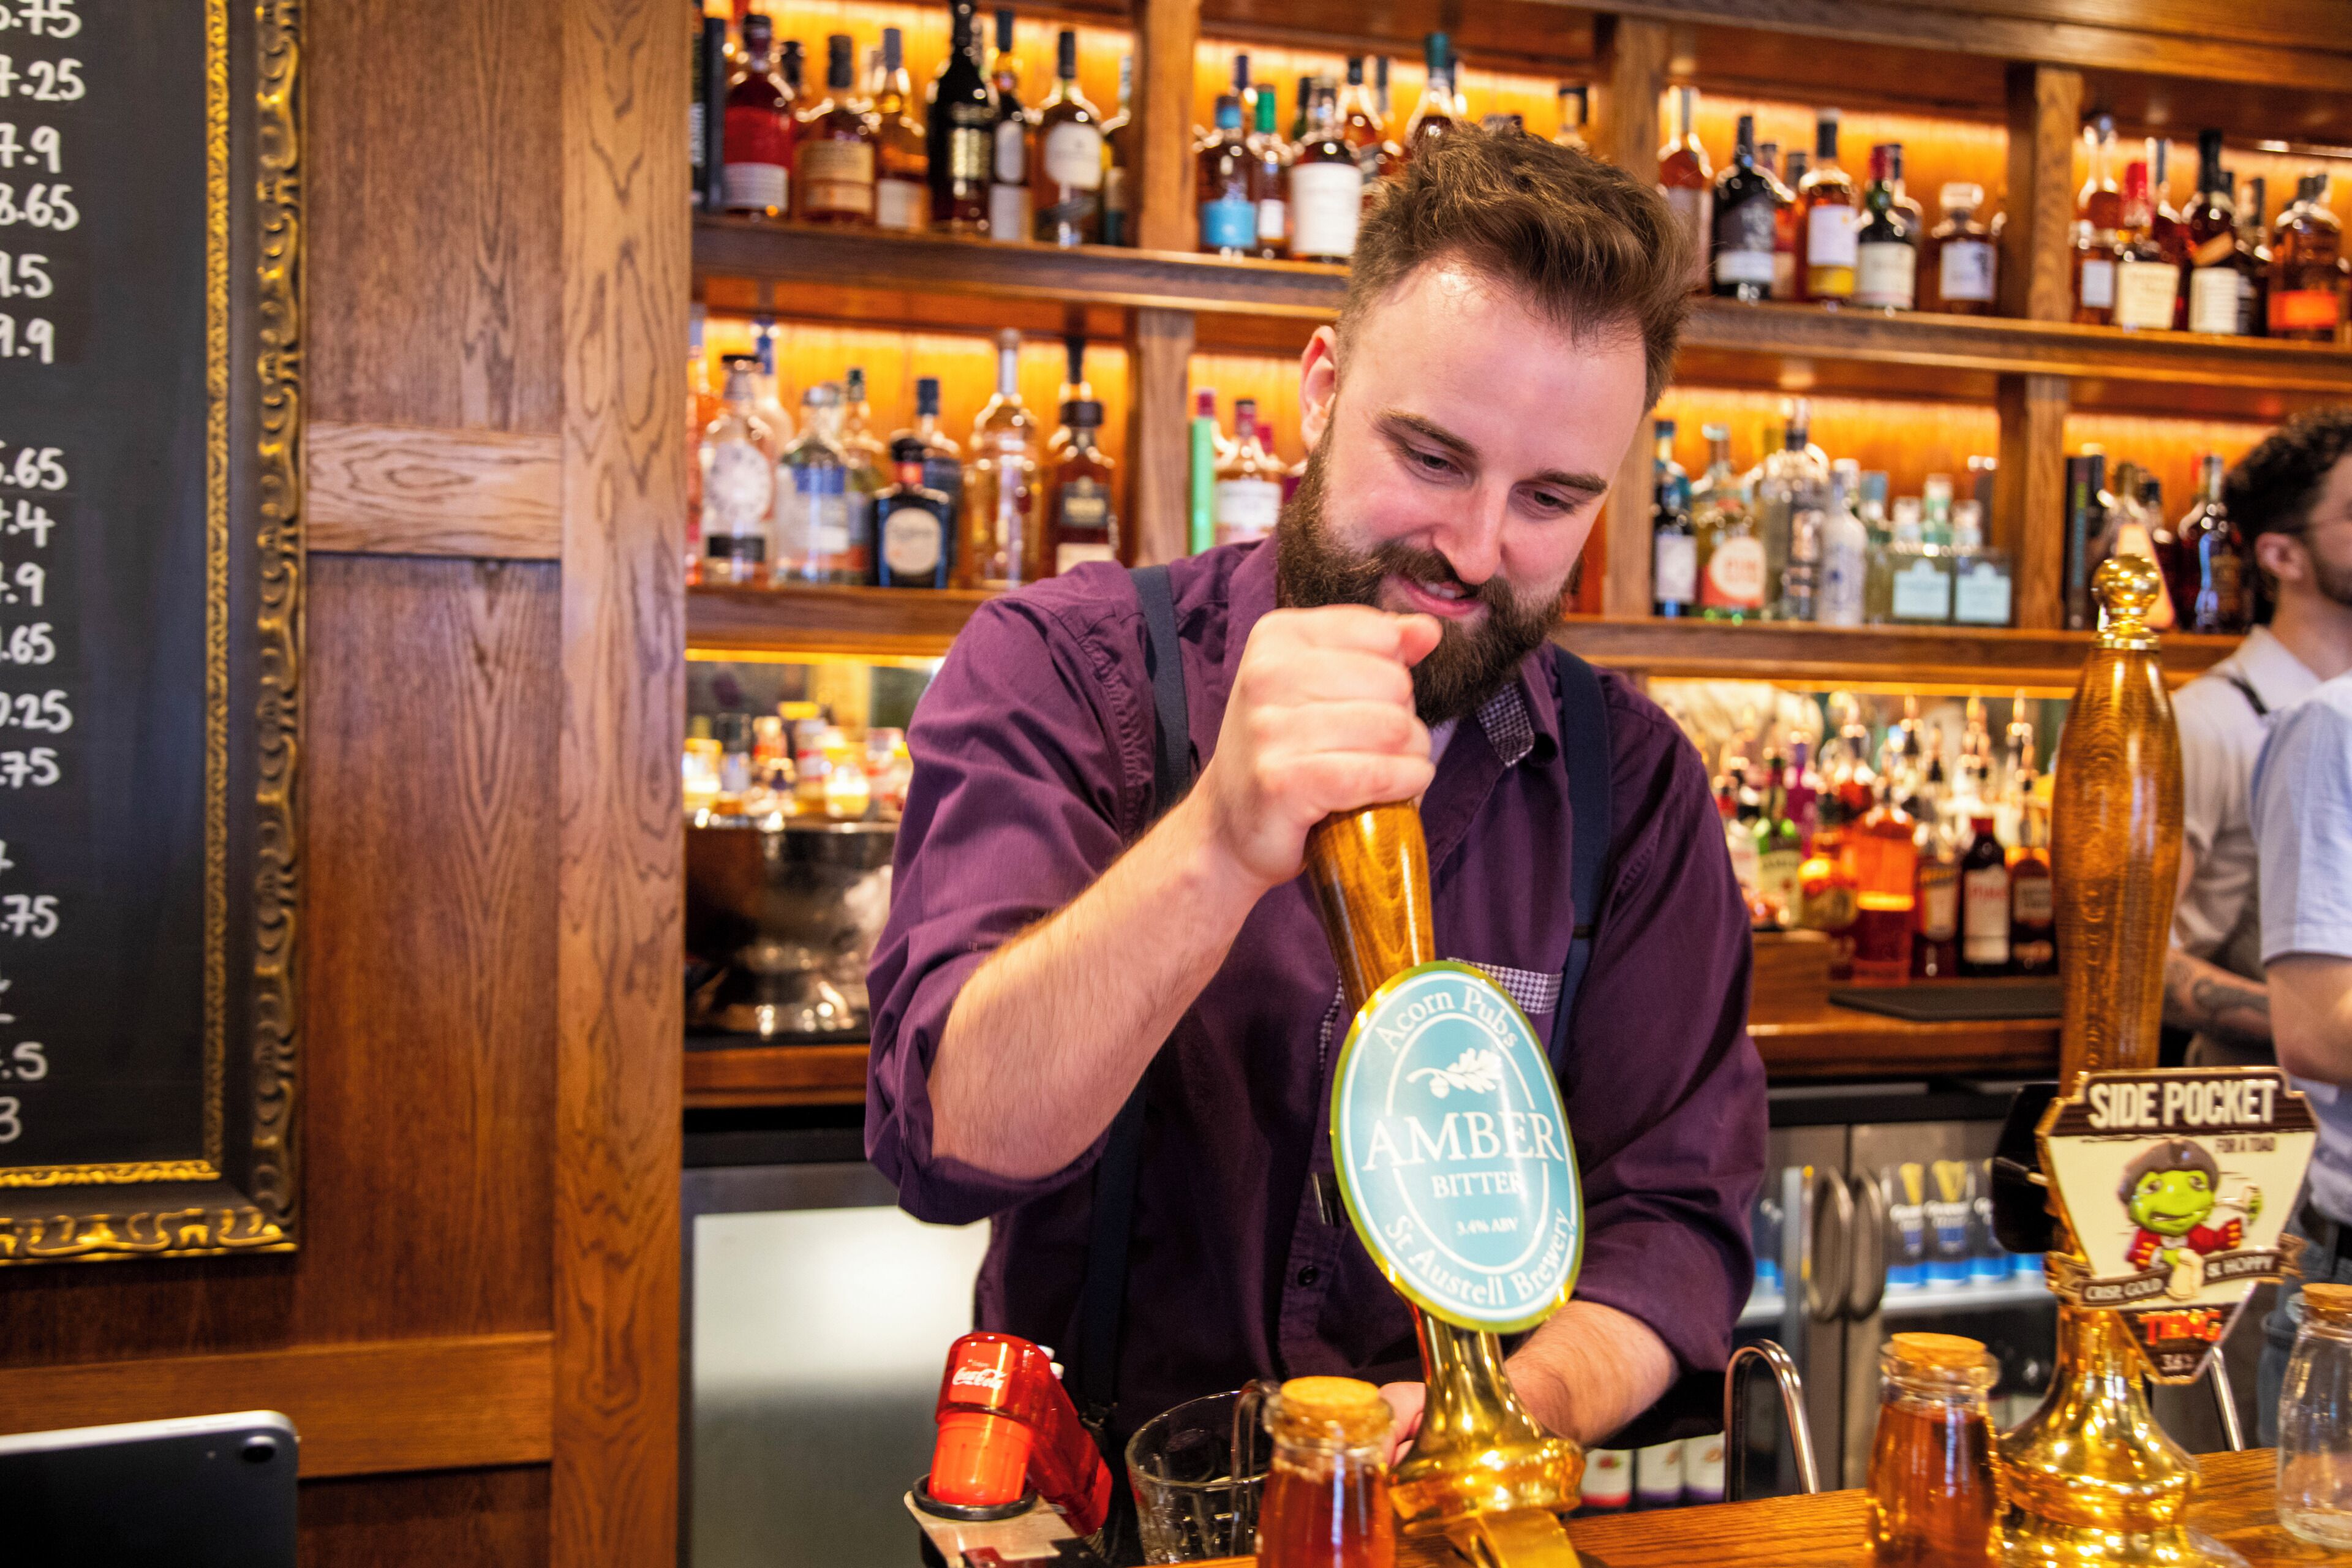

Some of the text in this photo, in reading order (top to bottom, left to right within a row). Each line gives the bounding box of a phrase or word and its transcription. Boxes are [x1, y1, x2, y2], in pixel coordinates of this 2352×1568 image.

[0, 439, 68, 491] .65
[0, 561, 45, 607] .9
[1376, 986, 1518, 1052] Acorn Pubs
[2087, 1080, 2278, 1129] SIDE POCKET
[1362, 1112, 1564, 1171] AMBER
[1431, 1171, 1525, 1199] BITTER
[1385, 1207, 1574, 1306] St Austell Brewery
[2124, 1278, 2163, 1298] GOLD
